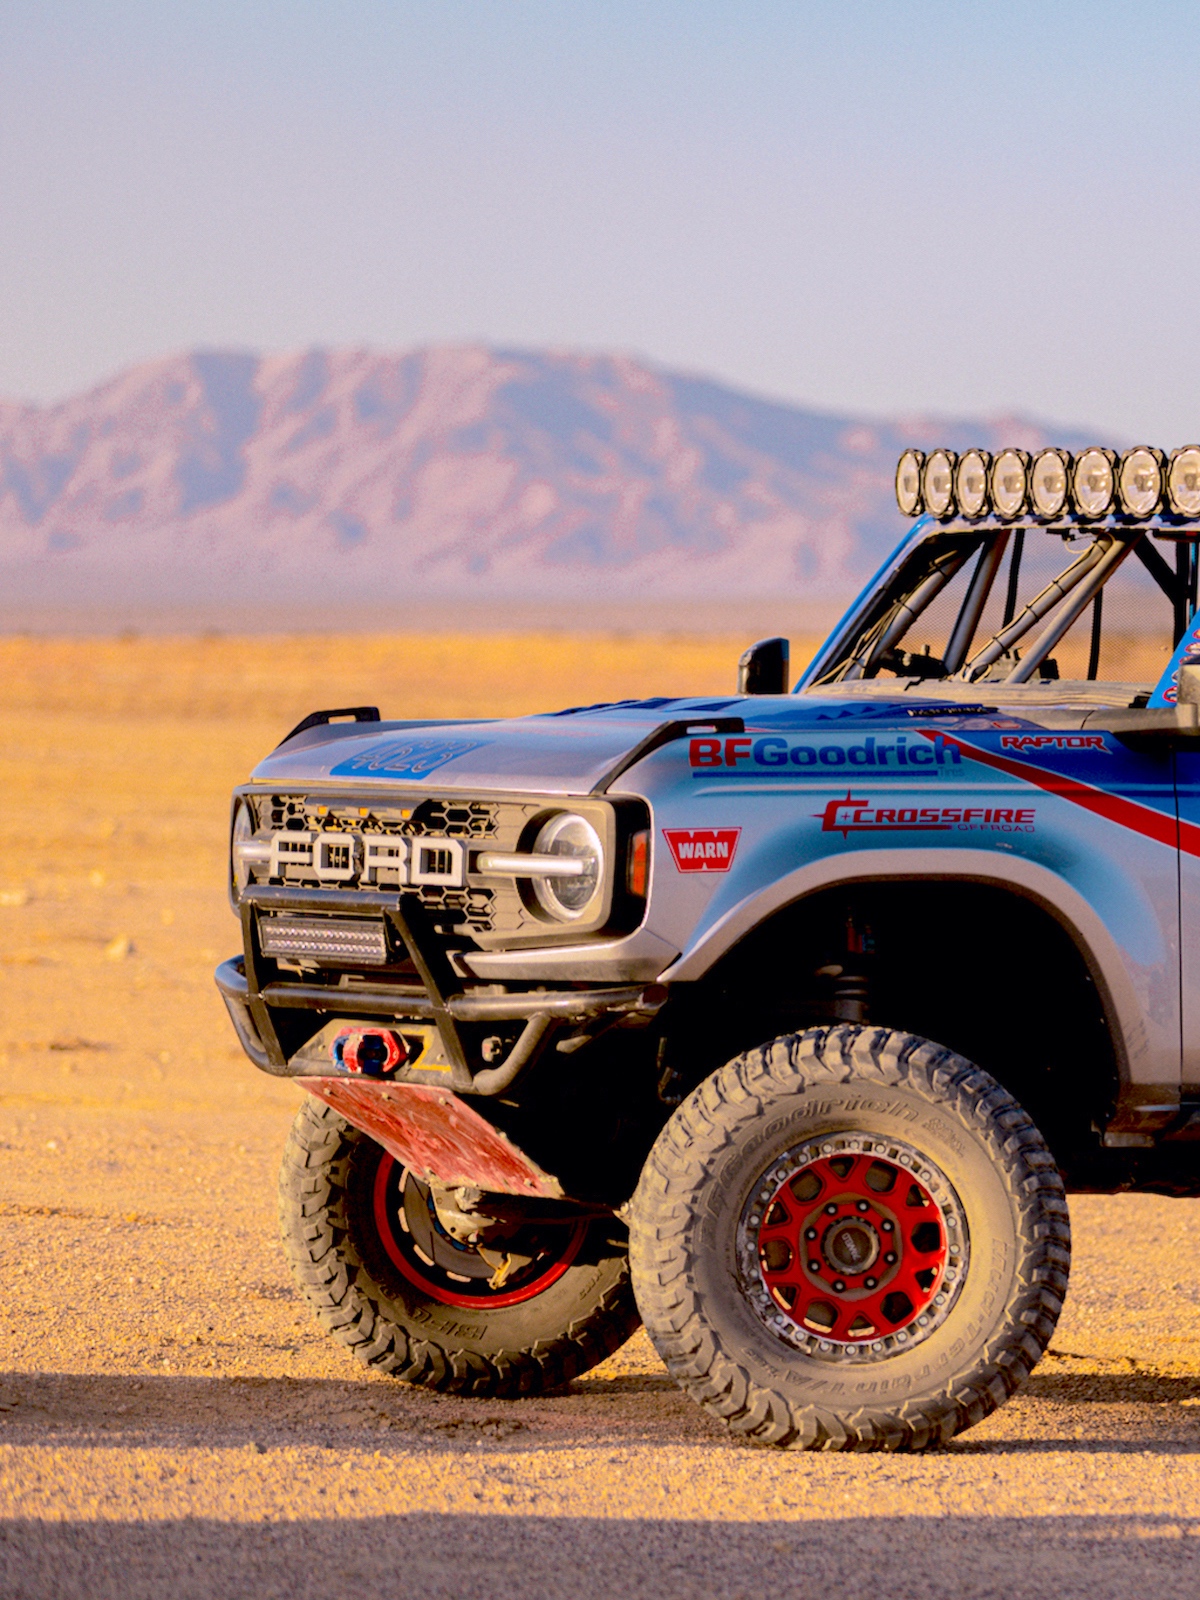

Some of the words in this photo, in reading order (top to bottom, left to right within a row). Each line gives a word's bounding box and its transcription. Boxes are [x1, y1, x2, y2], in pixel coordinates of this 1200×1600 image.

[688, 736, 962, 768] BFGoodrich
[1001, 735, 1113, 755] RAPTOR
[852, 808, 1036, 824] CROSSFIRE
[956, 824, 1036, 833] OFFROAD
[269, 831, 468, 887] FORD
[677, 841, 729, 859] WARN
